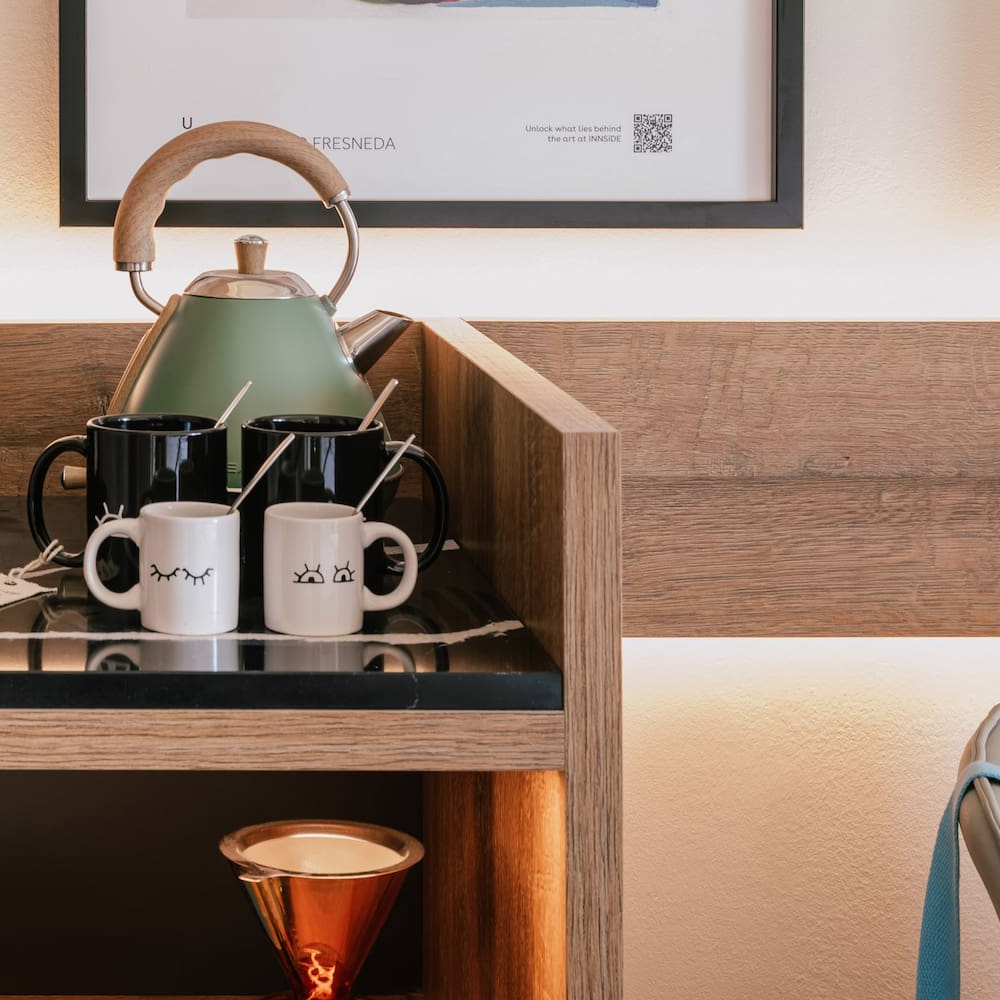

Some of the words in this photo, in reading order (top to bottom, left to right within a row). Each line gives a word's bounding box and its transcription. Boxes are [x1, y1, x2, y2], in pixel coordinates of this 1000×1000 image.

[182, 117, 193, 130] U
[525, 125, 552, 133] Unlock
[554, 125, 576, 133] what
[578, 125, 592, 133] lies
[594, 125, 622, 133] behind
[312, 137, 396, 150] FRESNEDA
[547, 135, 561, 143] the
[562, 135, 575, 143] art
[577, 135, 587, 143] at
